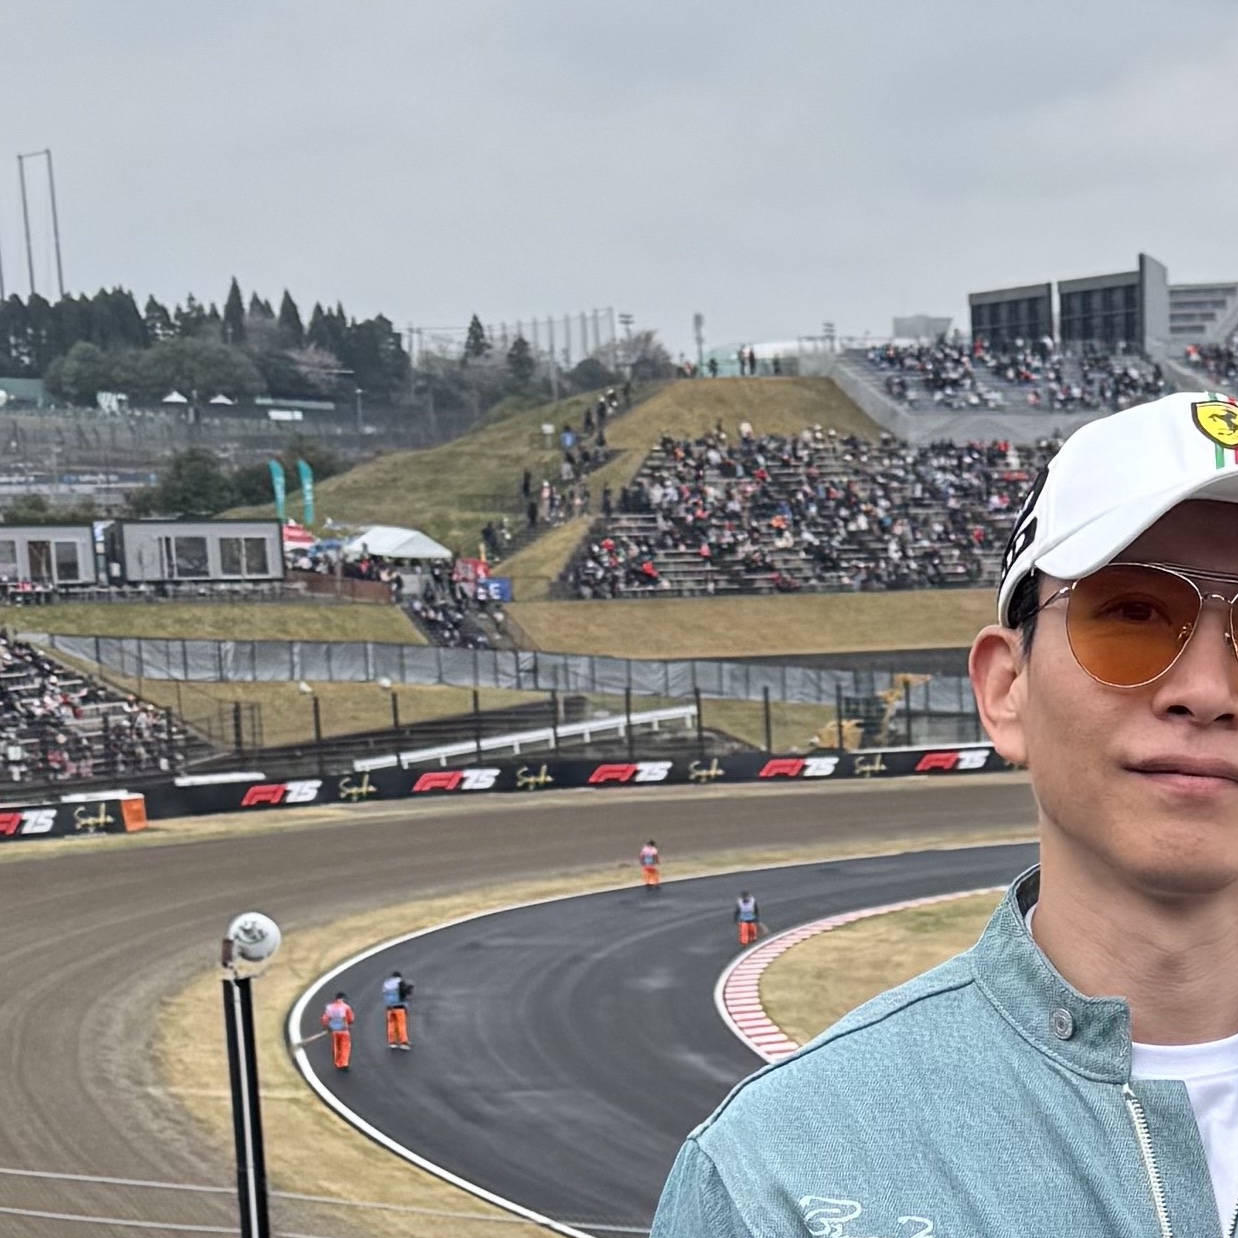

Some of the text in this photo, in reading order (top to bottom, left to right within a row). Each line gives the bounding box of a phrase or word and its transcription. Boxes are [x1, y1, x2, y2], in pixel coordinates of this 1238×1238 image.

[588, 763, 638, 784] F1
[758, 758, 806, 777] F1
[412, 770, 465, 792] F1
[240, 783, 288, 807] F1
